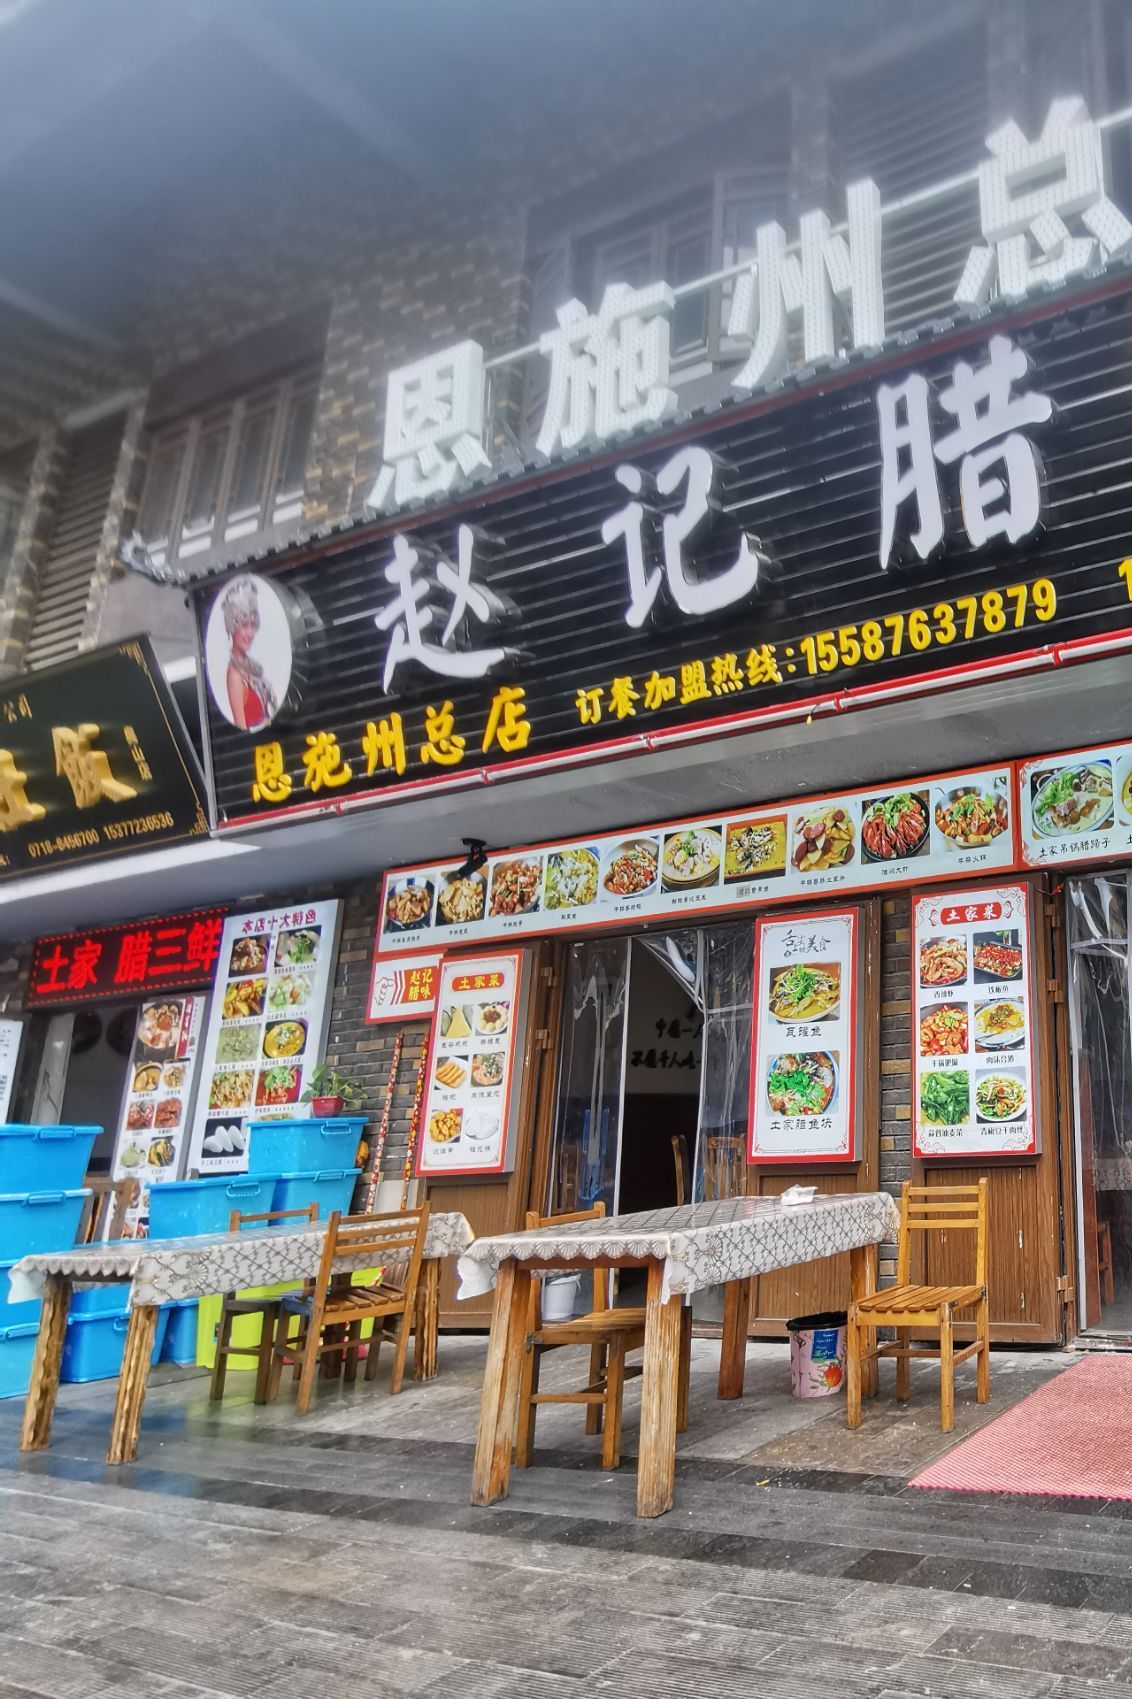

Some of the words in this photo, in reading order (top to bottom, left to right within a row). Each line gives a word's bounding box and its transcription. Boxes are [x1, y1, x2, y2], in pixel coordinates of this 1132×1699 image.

[253, 686, 531, 802] 恩施州总店
[946, 904, 998, 921] 土家菜
[36, 939, 102, 993] 土家
[113, 917, 223, 984] 腊三鲜
[409, 968, 433, 985] 赵记
[458, 972, 501, 991] 土家菜
[408, 985, 431, 1002] 腊味
